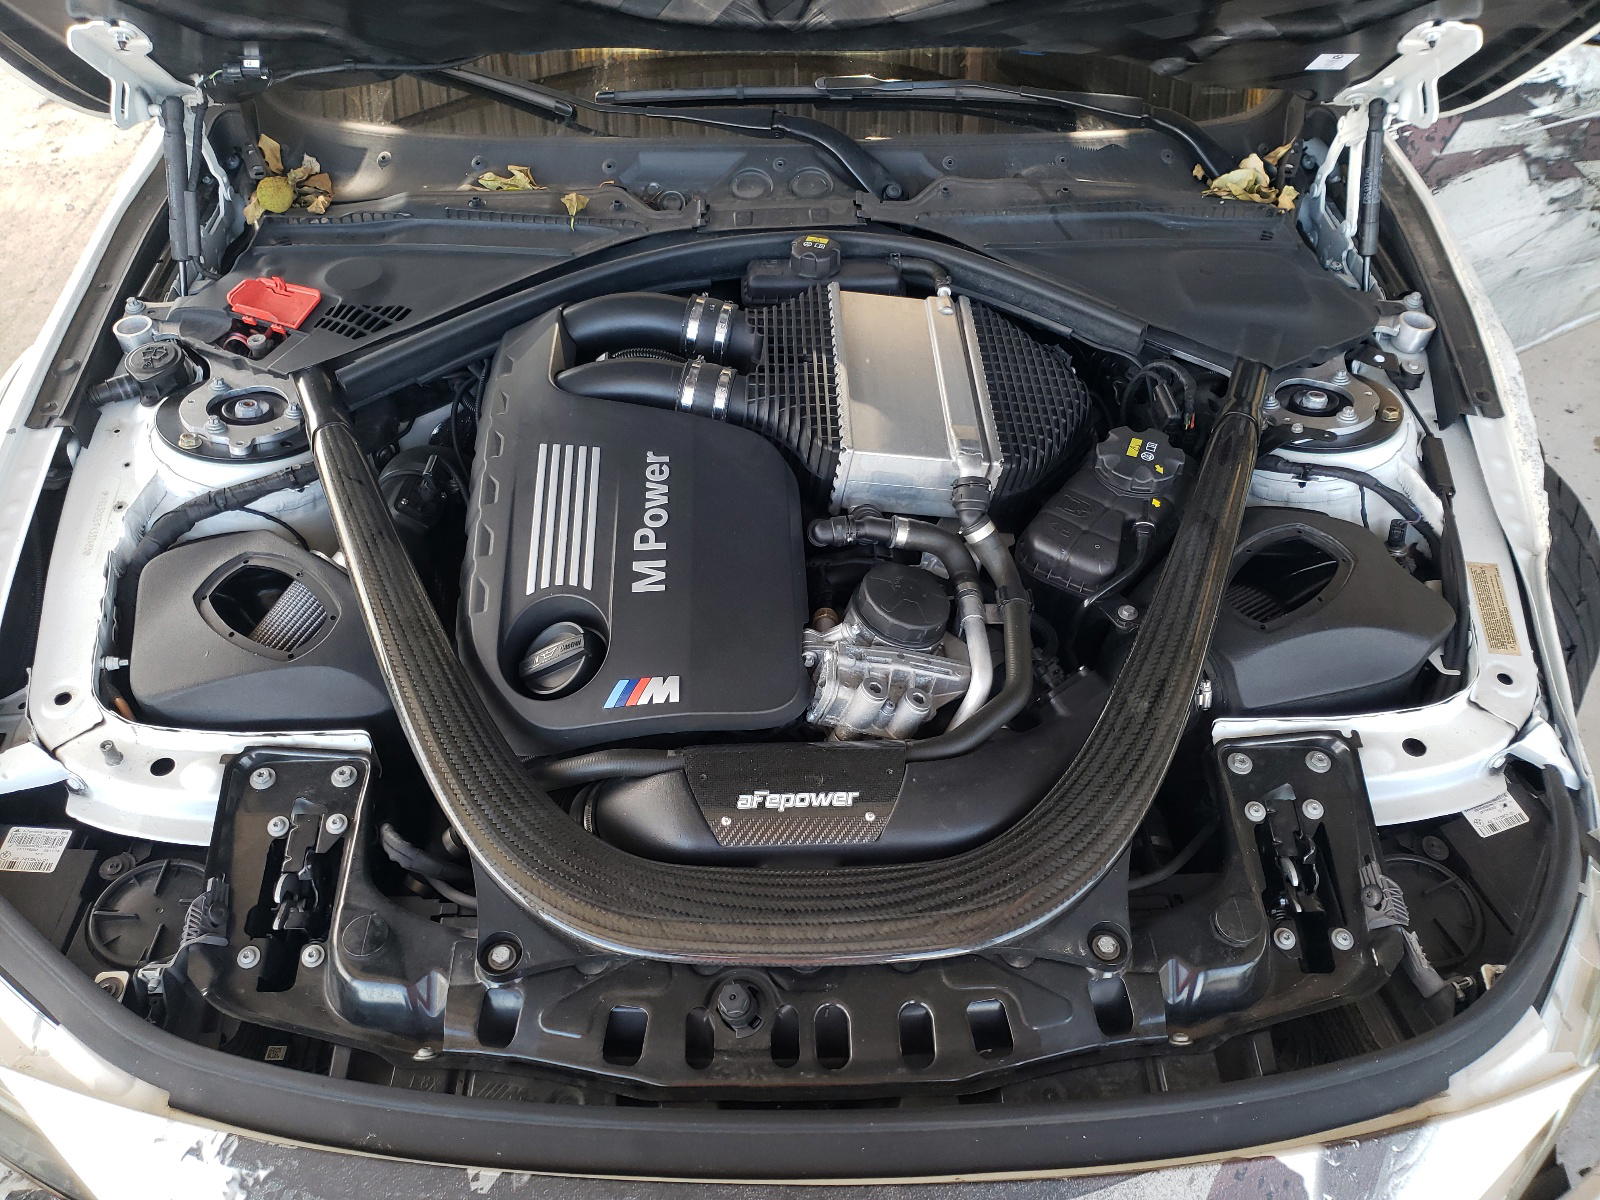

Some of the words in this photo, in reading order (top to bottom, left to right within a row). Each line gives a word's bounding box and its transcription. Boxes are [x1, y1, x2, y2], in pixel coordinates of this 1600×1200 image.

[633, 450, 670, 551] Power
[631, 559, 667, 593] M
[635, 675, 680, 706] M
